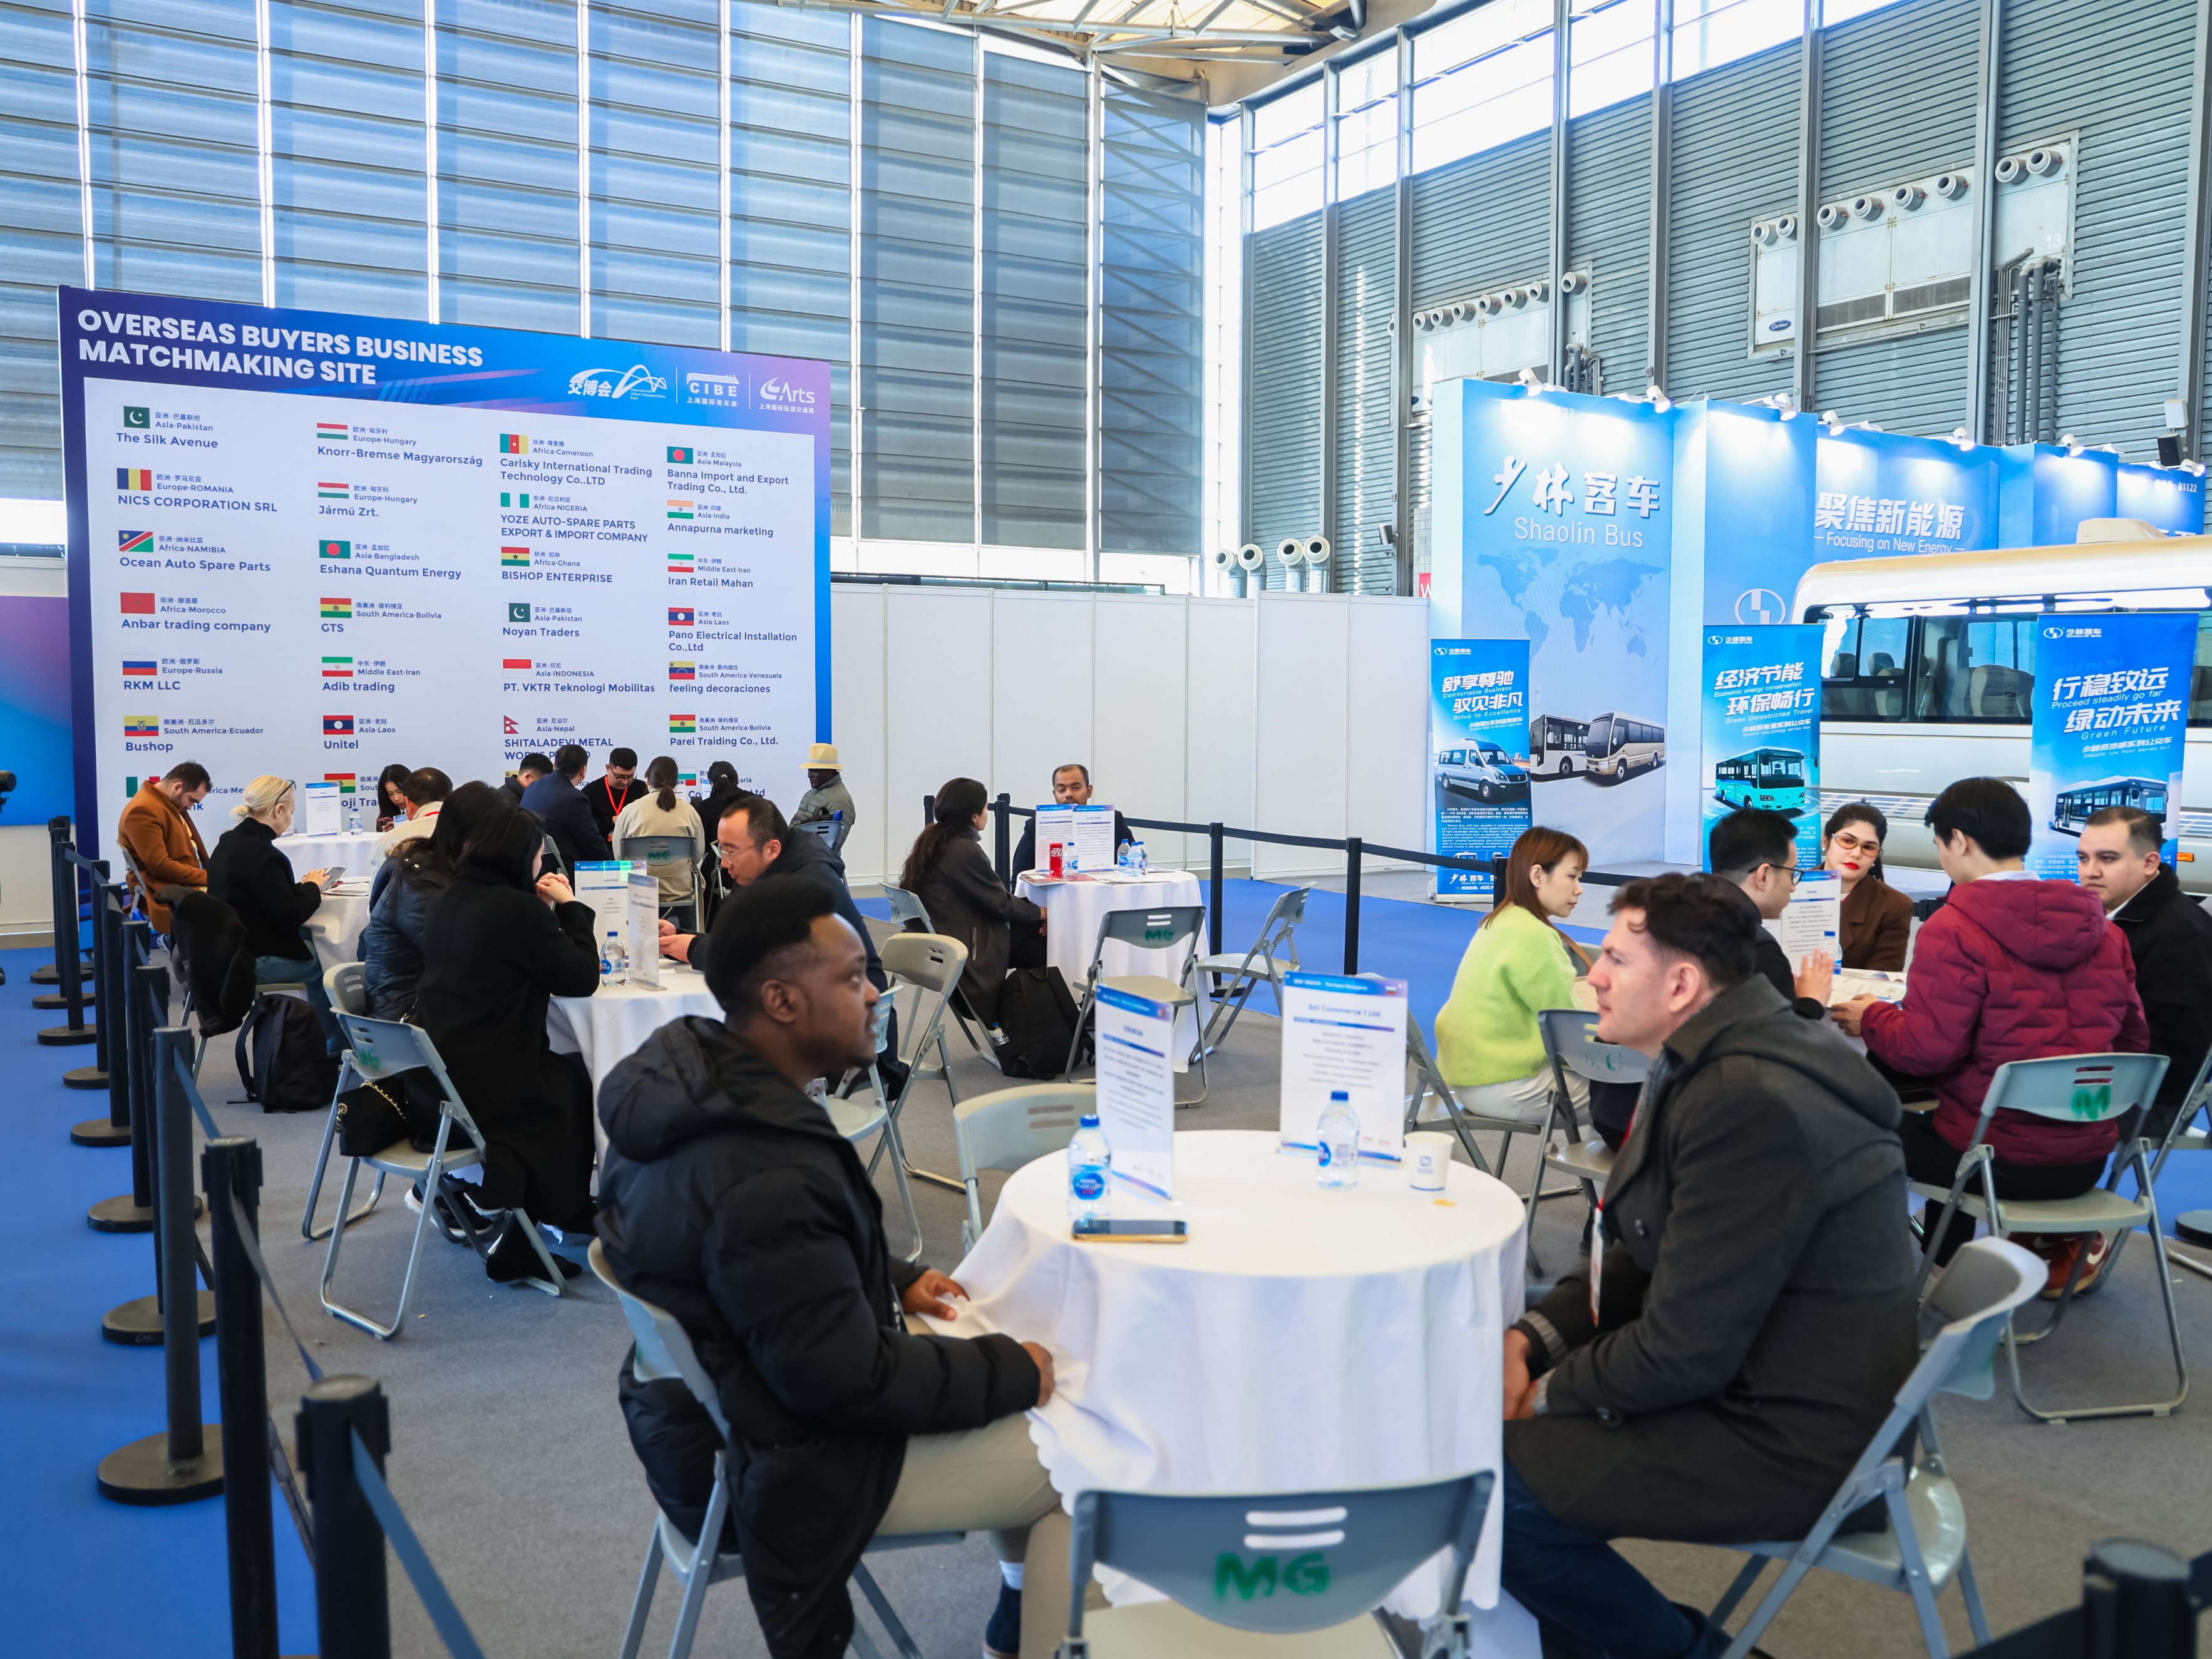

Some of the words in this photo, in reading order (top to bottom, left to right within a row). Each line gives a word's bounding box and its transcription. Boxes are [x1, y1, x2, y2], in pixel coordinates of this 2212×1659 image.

[2045, 234, 2061, 249] 13
[1771, 322, 1789, 330] Carrier
[78, 310, 235, 344] OVERSEAS
[242, 326, 350, 354] BUYERS
[357, 337, 483, 366] BUSINESS
[1575, 332, 1585, 343] 12
[80, 339, 314, 379] MATCHMAKING
[321, 361, 376, 384] SITE
[568, 378, 612, 398] 交博会
[690, 383, 737, 397] CIBE
[687, 397, 737, 407] 上海国际客车展
[759, 403, 814, 414] 上海国际轨道交通展
[116, 433, 140, 443] The
[144, 434, 167, 444] Silk
[170, 437, 218, 448] Avenue
[318, 446, 399, 460] Knorr-Bremse
[404, 452, 482, 467] Magyarország
[500, 458, 540, 470] Carlsky
[543, 461, 610, 473] International
[614, 466, 652, 478] Trading
[500, 471, 563, 485] Technology
[668, 470, 697, 478] Banna
[701, 471, 734, 481] Import
[758, 475, 788, 485] Export
[667, 481, 704, 493] Trading
[708, 484, 726, 493] Co.,
[1483, 455, 1659, 518] 少林客车
[2178, 483, 2197, 492] B1122
[118, 495, 150, 505] NICS
[154, 497, 250, 510] CORPORATION
[255, 502, 277, 511] SRL
[359, 508, 378, 516] Zrt.
[1814, 492, 1965, 540] 聚焦新能源
[501, 515, 529, 523] YOZE
[532, 516, 600, 527] AUTO-SPARE
[604, 520, 635, 529] PARTS
[502, 528, 543, 537] EXPORT
[555, 530, 594, 540] IMPORT
[597, 532, 647, 542] COMPANY
[667, 523, 721, 534] Annapurna
[725, 526, 773, 538] marketing
[1515, 516, 1596, 545] Shaolin
[1605, 523, 1644, 548] Bus
[1827, 532, 1875, 553] Focusing
[1877, 539, 1890, 551] on
[1893, 537, 1916, 552] New
[1918, 540, 1952, 554] Energy
[120, 557, 161, 567] Ocean
[165, 559, 195, 568] Auto
[200, 560, 235, 571] Spare
[240, 562, 270, 571] Parts
[321, 565, 361, 574] Eshana
[366, 567, 418, 576] Quantum
[423, 568, 461, 580] Energy
[502, 571, 543, 580] BISHOP
[547, 573, 612, 582] ENTERPRISE
[691, 578, 718, 586] Retail
[721, 579, 753, 587] Mahan
[121, 619, 160, 629] Anbar
[165, 620, 210, 632] trading
[214, 623, 270, 633] company
[321, 624, 344, 632] GTS
[503, 627, 537, 637] Noyan
[540, 628, 579, 636] Traders
[697, 631, 741, 639] Electrical
[744, 632, 796, 640] Installation
[669, 643, 703, 652] Co.,Ltd
[1442, 670, 1514, 693] 舒享尊驰
[1714, 662, 1804, 691] 经济节能
[124, 681, 153, 689] RKM
[158, 681, 180, 690] LLC
[322, 682, 349, 691] Adib
[353, 682, 394, 693] trading
[554, 684, 605, 694] Teknologi
[609, 684, 655, 692] Mobilitas
[669, 684, 703, 694] feeling
[706, 684, 770, 692] decoraciones
[1714, 689, 1742, 697] Economic
[1765, 682, 1801, 691] conservation
[2052, 667, 2169, 701] 行稳致远
[1443, 690, 1481, 699] Comfortable
[2052, 699, 2090, 709] Proceed
[2093, 694, 2129, 704] steadily
[2132, 693, 2145, 701] go
[1453, 692, 1523, 714] 驭见非凡
[1726, 687, 1815, 717] 环保畅行
[1485, 709, 1521, 717] Excellence
[1748, 711, 1790, 721] Unrestricted
[2064, 700, 2182, 734] 绿动未来
[2081, 731, 2117, 740] Green
[2124, 725, 2166, 735] Future
[126, 742, 173, 752] Bushop
[324, 740, 358, 749] Unitel
[505, 739, 575, 747] SHITALADEVI
[579, 738, 614, 746] METAL
[697, 737, 736, 747] Traiding
[1145, 928, 1175, 942] MG
[1215, 1553, 1329, 1601] MG
